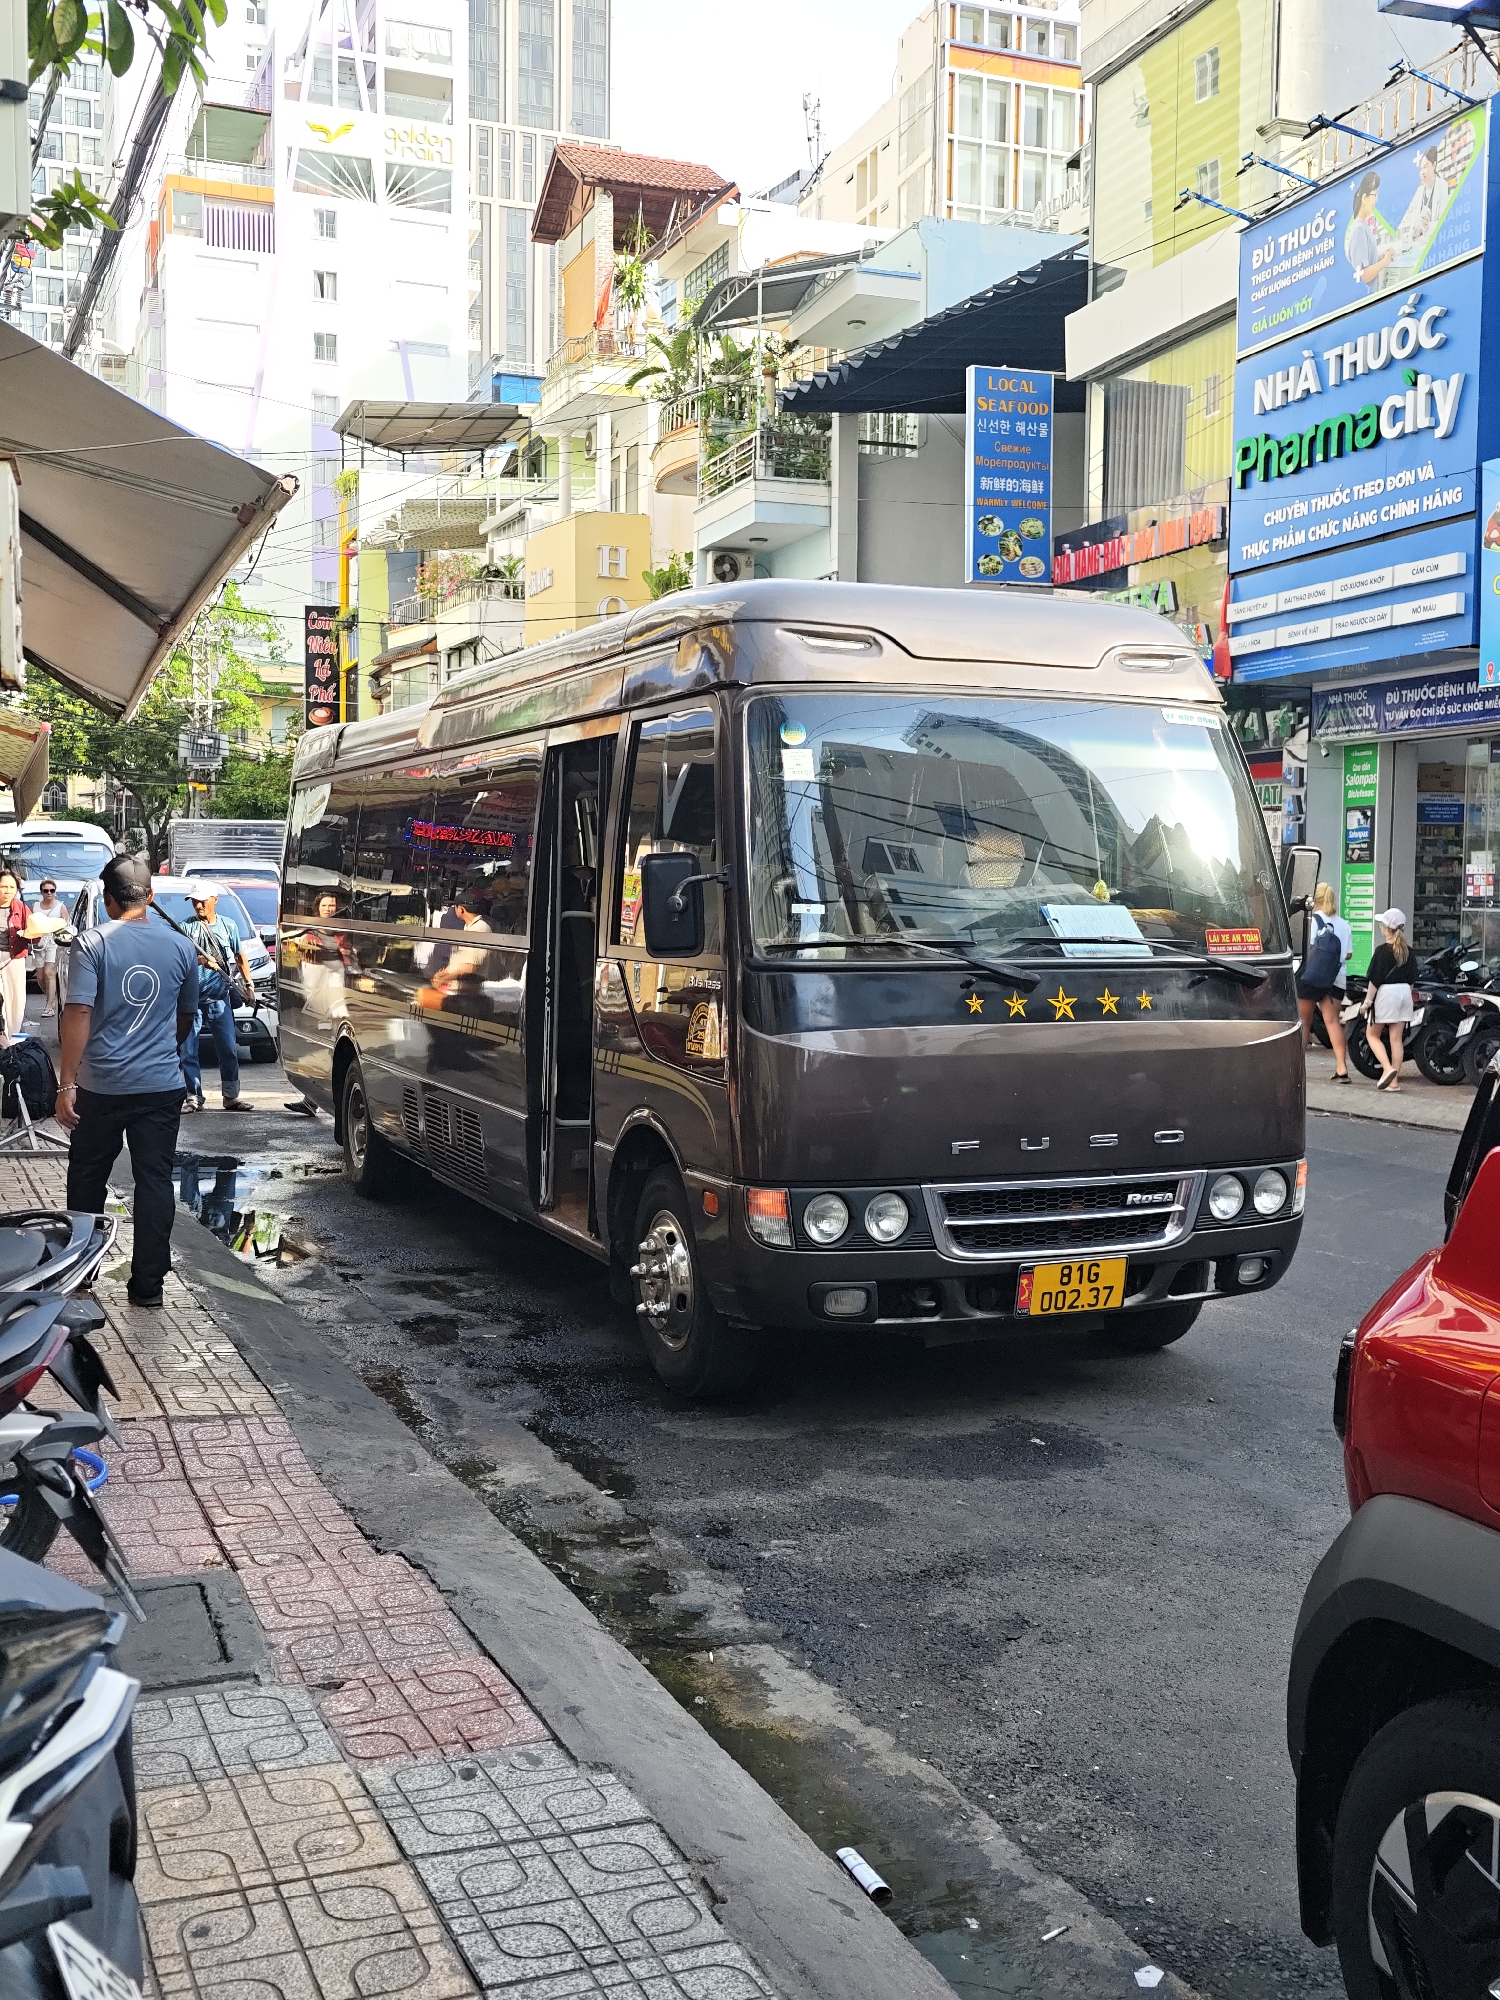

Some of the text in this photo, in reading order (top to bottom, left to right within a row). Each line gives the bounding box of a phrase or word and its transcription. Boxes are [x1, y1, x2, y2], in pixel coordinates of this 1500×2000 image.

[1252, 207, 1336, 270] ĐỦ THUỐC
[1251, 237, 1334, 286] THEO ĐƠN BỆNH VIỆN
[1251, 255, 1334, 302] CHẤT LƯỢNG CHÍNH HÃNG
[1252, 295, 1313, 334] GIÁ LUÔN TỐT
[1254, 293, 1448, 415] NHÀ THUỐC
[988, 376, 1037, 394] LOCAL
[977, 396, 1049, 416] SEAFOOD
[977, 418, 1049, 438] 신선한 해산물
[1235, 369, 1465, 489] Pharmacity
[994, 441, 1031, 454] Свежие
[976, 455, 1049, 472] Морепродукты
[980, 476, 1044, 495] 新鲜的海鲜
[1264, 460, 1435, 527] CHUYÊN THUỐC THEO ĐƠN VÀ
[977, 497, 1048, 510] WARMLY WELCOME
[1242, 487, 1463, 561] THỰC PHẨM CHỨC NĂNG CHÍNH HÃNG
[1074, 541, 1103, 580] HÀNG
[1411, 563, 1439, 576] CẢM CÚM
[1328, 688, 1368, 705] NHÀ THUỐC
[1386, 687, 1400, 705] ĐỦ
[1402, 683, 1436, 704] THUỐC
[1437, 682, 1465, 702] BỆNH
[1421, 704, 1435, 718] CHỈ
[1436, 703, 1446, 715] SỐ
[1447, 700, 1461, 714] SỨC
[1462, 698, 1484, 712] KHỎE
[1345, 773, 1377, 787] Salonpas
[1209, 932, 1258, 942] LÁI XE AN TOÀN
[122, 964, 160, 1036] 9
[951, 1130, 1185, 1154] FUSO
[1060, 1263, 1100, 1286] 81G
[1040, 1286, 1114, 1312] 002.37
